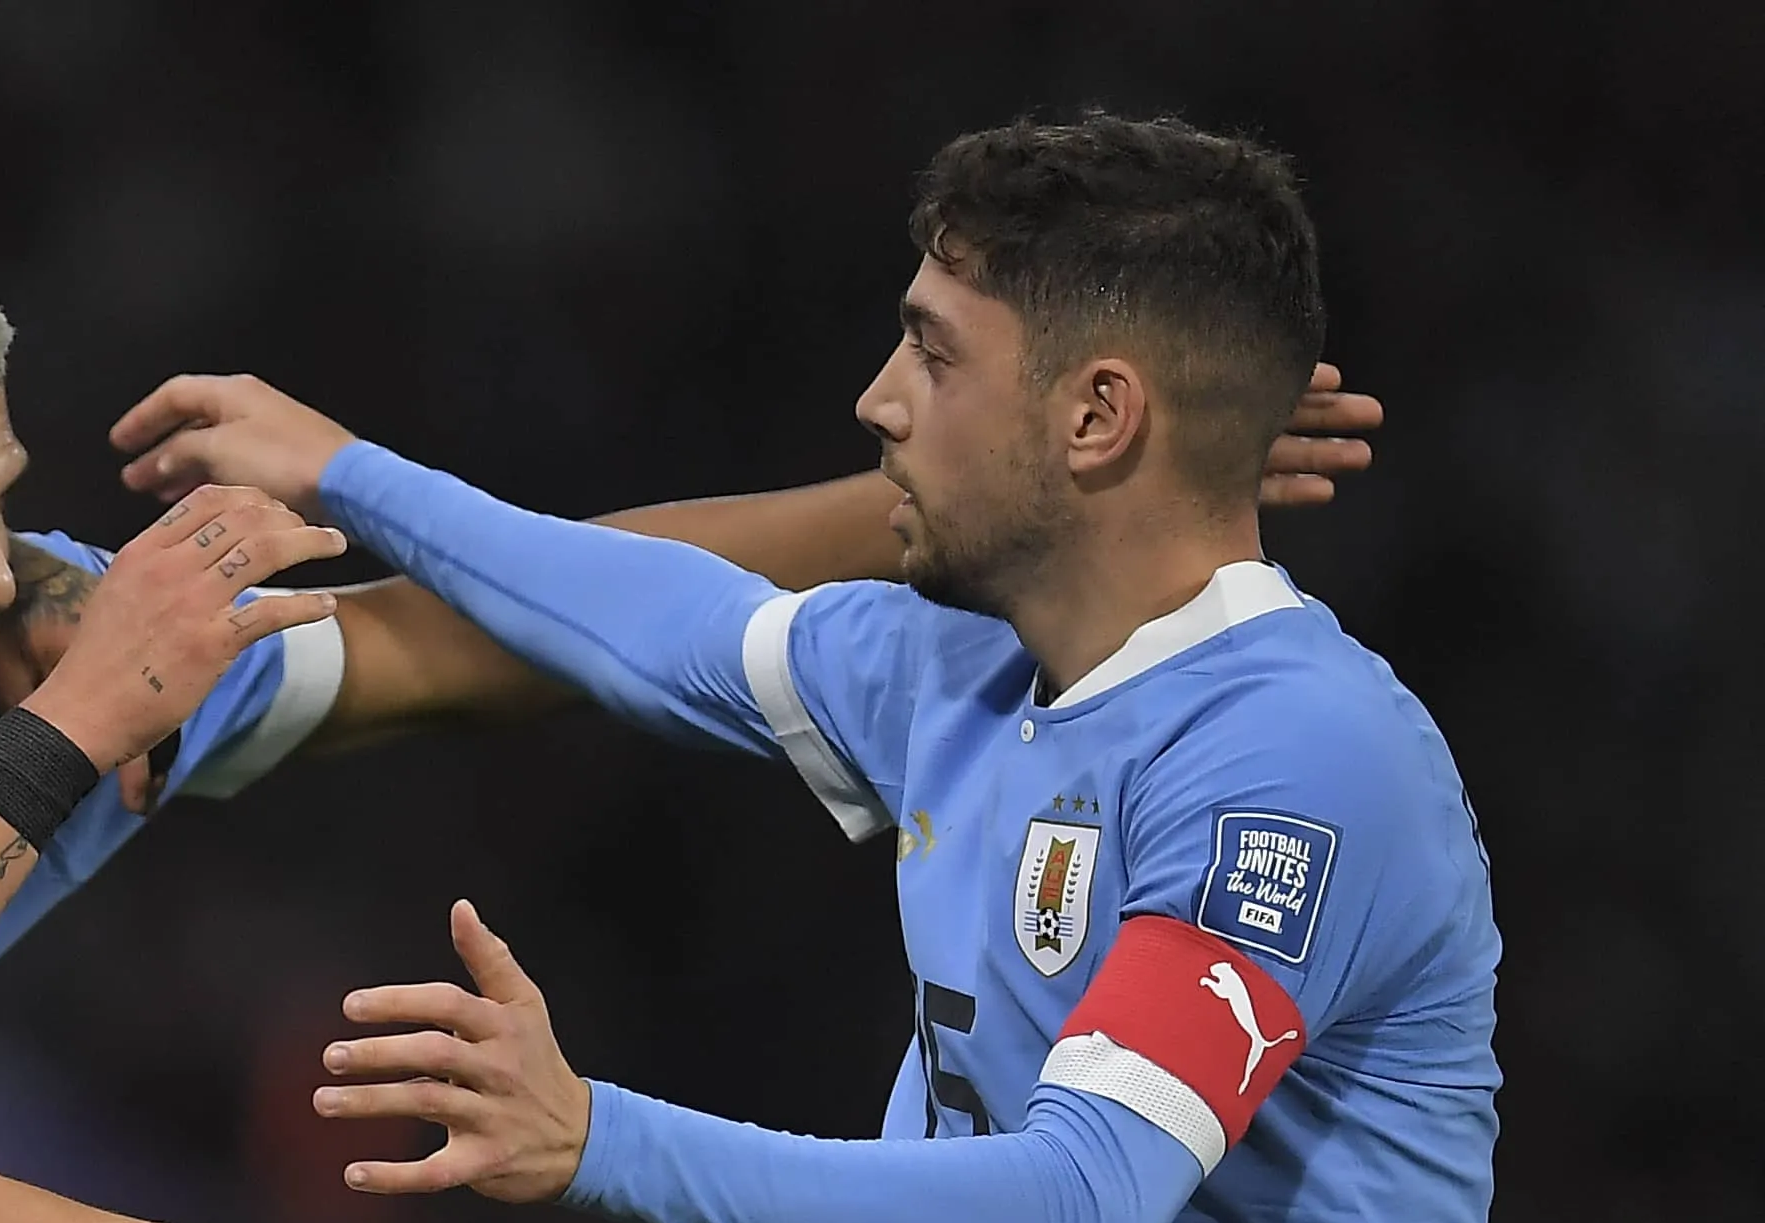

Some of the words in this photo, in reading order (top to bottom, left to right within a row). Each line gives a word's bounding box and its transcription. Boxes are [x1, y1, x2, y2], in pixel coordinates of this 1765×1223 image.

[1239, 830, 1311, 862] FOOTBALL
[1236, 850, 1309, 889] UNITES
[1227, 871, 1254, 895] the
[1255, 878, 1307, 916] World
[1245, 908, 1275, 926] FIFA
